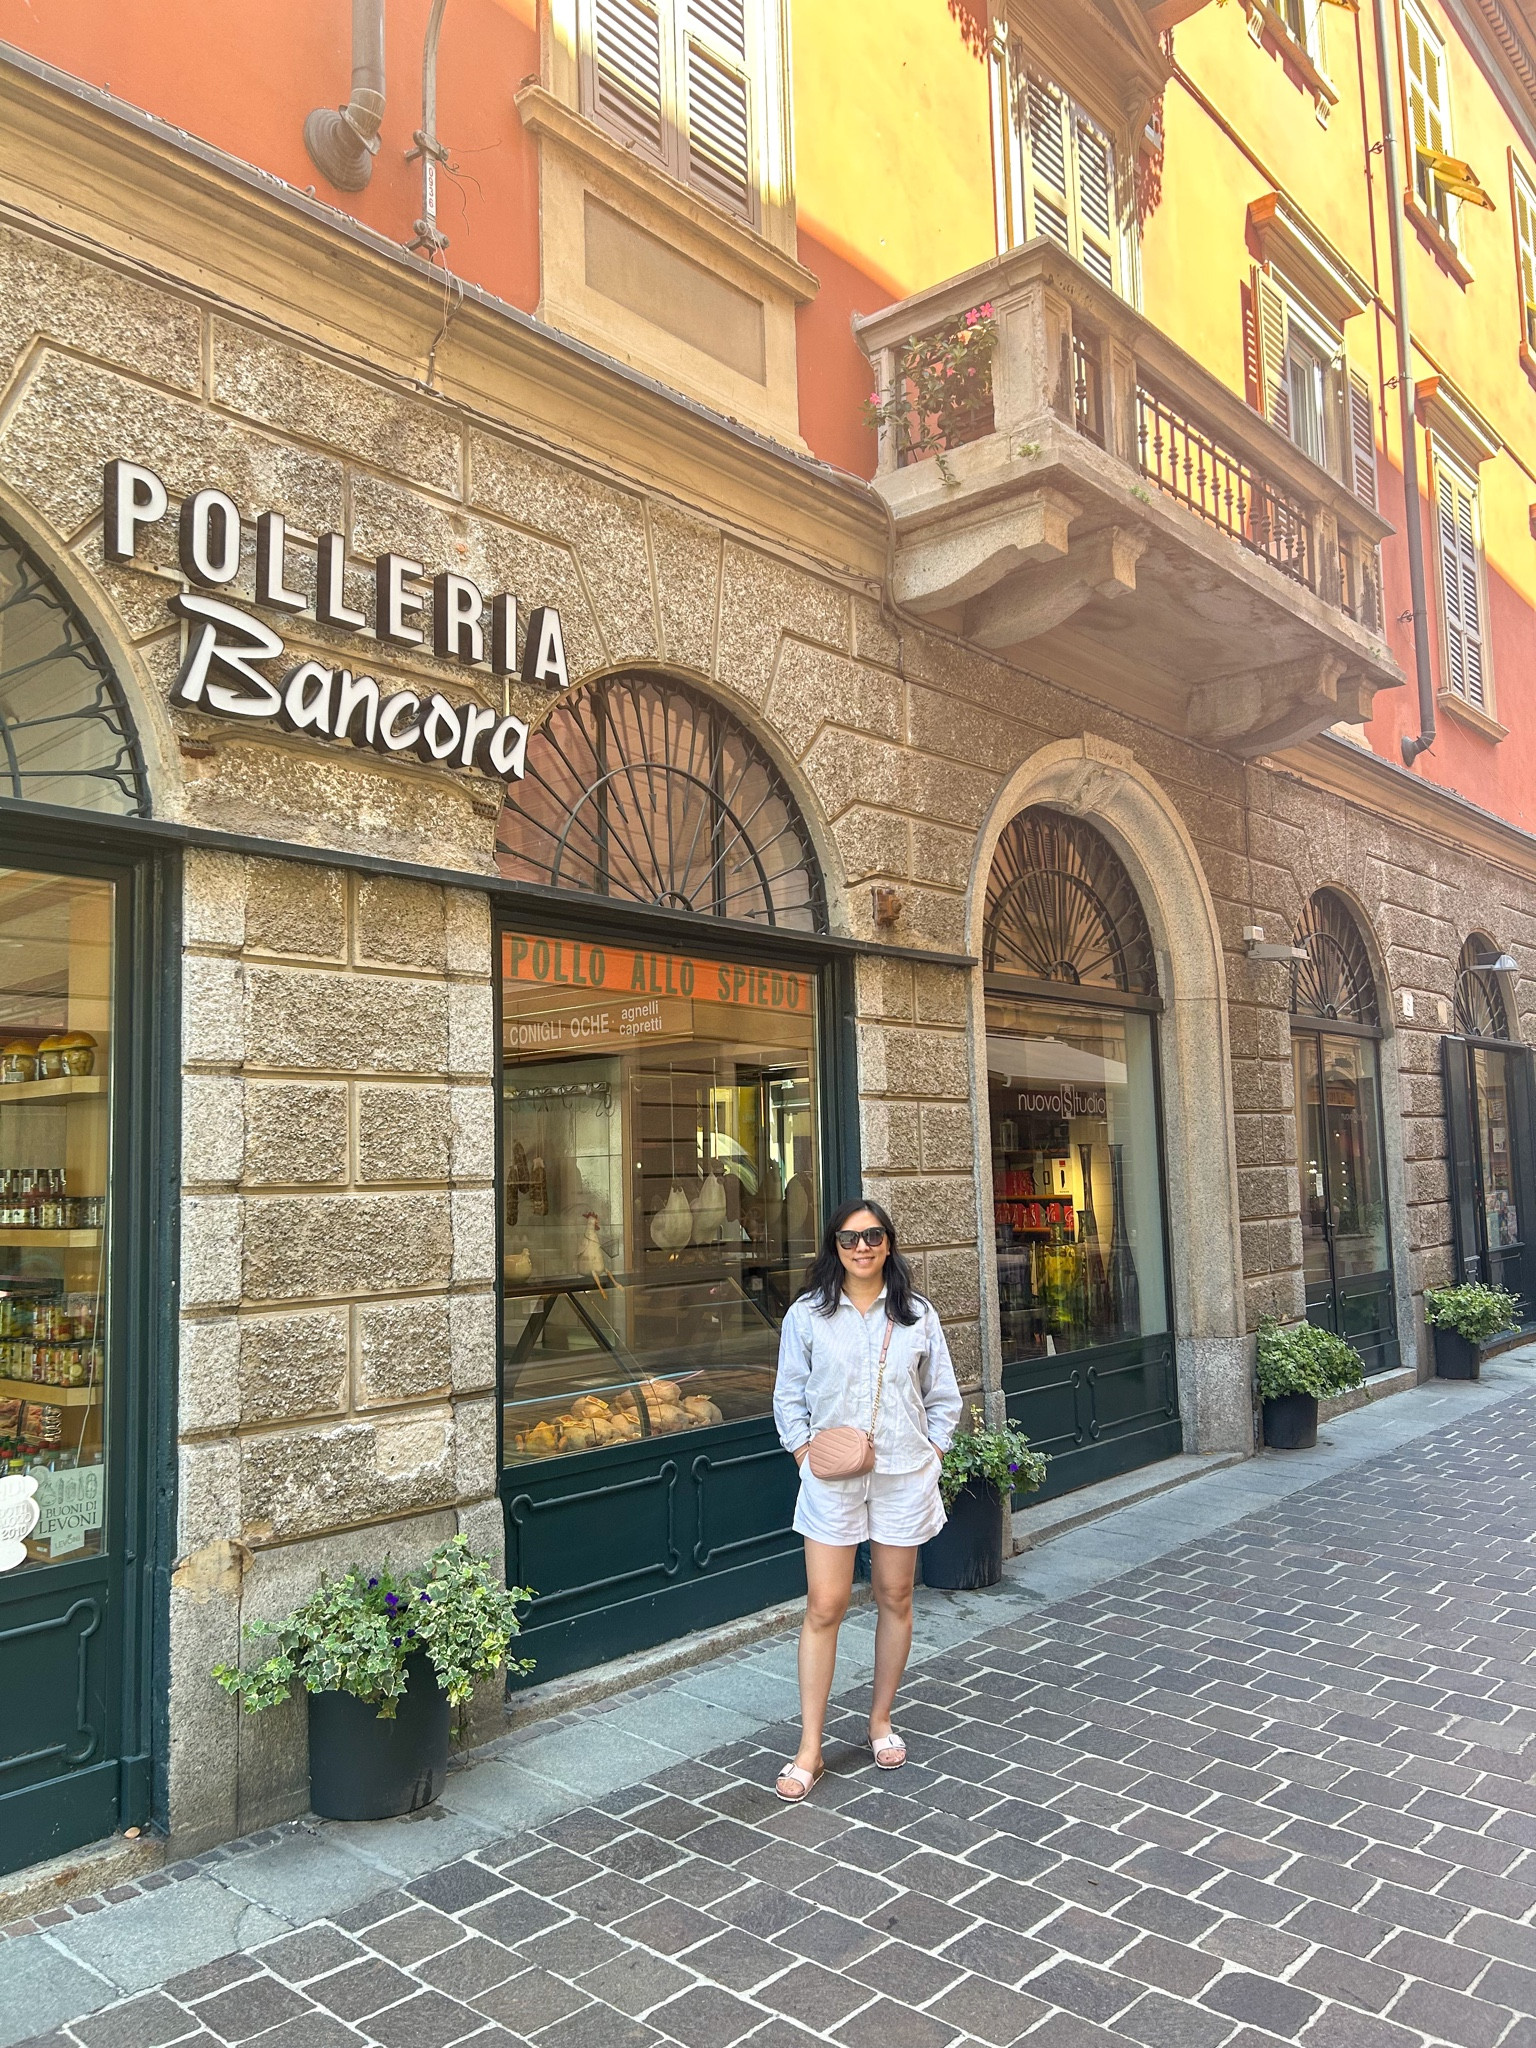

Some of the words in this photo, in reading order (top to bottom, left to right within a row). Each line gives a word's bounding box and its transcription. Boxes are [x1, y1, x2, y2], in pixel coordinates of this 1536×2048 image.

[104, 458, 569, 689] POLLERIA
[169, 593, 529, 782] Bancora
[510, 936, 606, 986] POLLO
[631, 952, 695, 997] ALLO
[717, 965, 800, 1009] SPIEDO
[621, 1001, 659, 1022] agnelli
[510, 1020, 562, 1045] CONIGLI
[570, 1013, 610, 1038] OCHE
[619, 1016, 662, 1036] capretti
[39, 1511, 96, 1534] LEVONI
[46, 1503, 82, 1518] BUONI
[86, 1500, 97, 1511] DI
